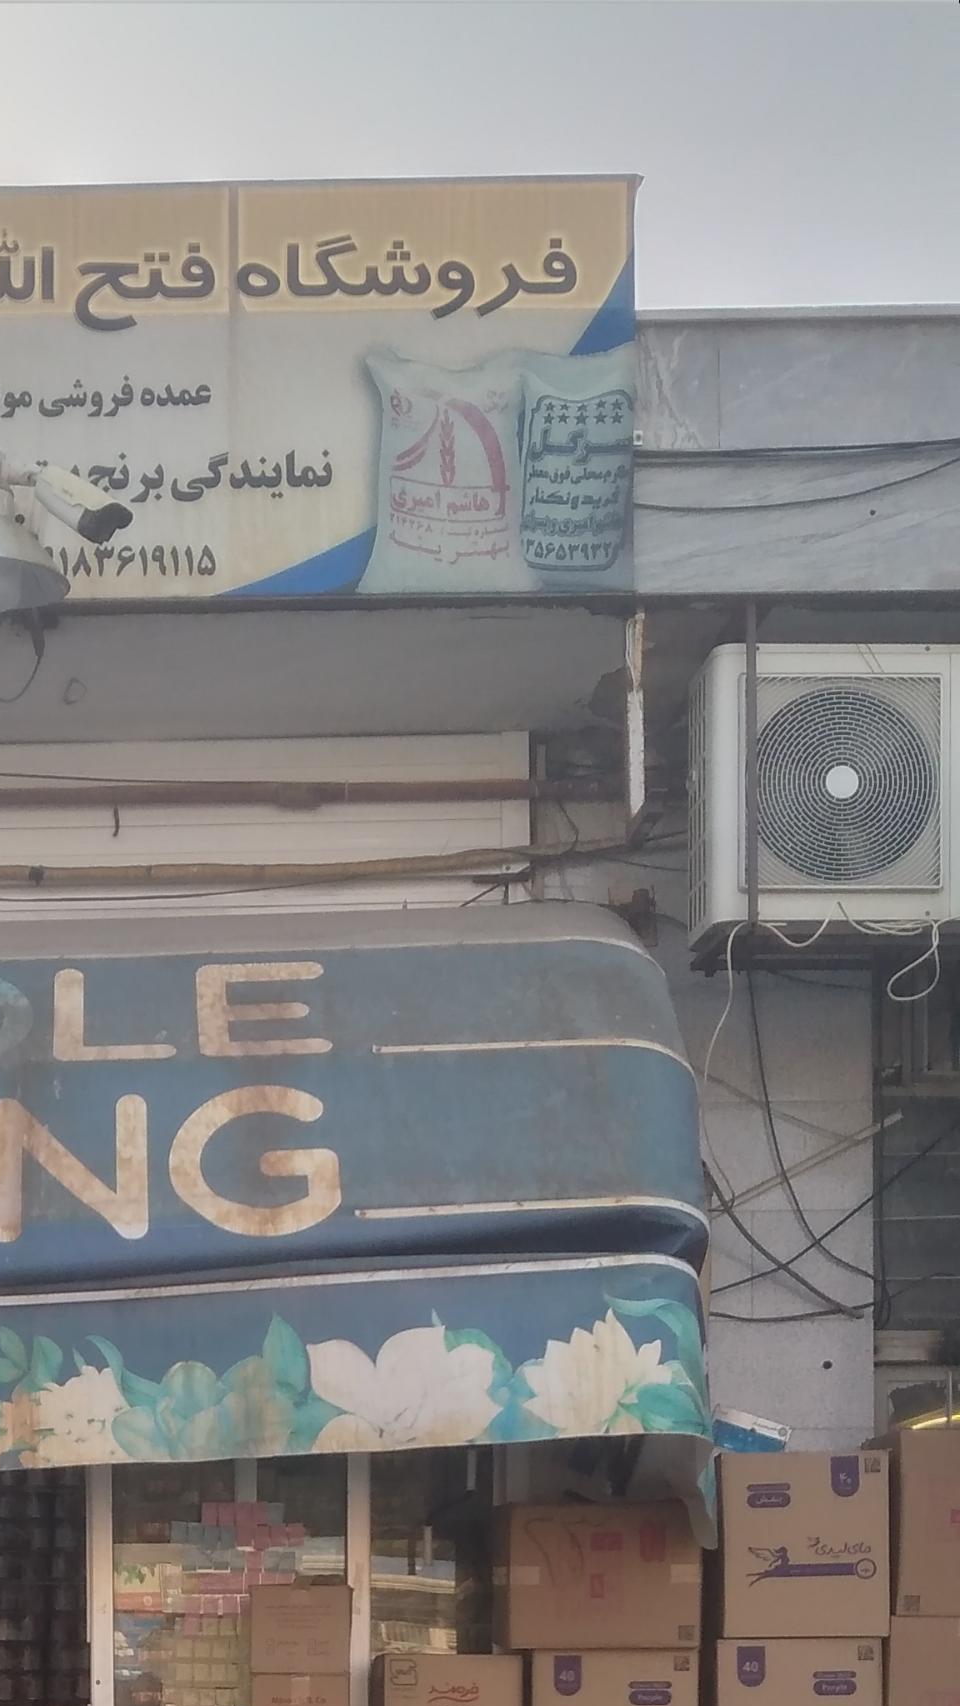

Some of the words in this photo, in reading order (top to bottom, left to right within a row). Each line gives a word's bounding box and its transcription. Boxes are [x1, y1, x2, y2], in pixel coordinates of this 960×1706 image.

[74, 241, 216, 331] فتح
[235, 233, 580, 319] فروشگاه
[38, 376, 134, 418] فروشی
[140, 381, 212, 408] عمده
[87, 452, 165, 502] برنج
[170, 447, 333, 502] نمایندگی
[447, 491, 491, 518] هاشم
[44, 541, 217, 579] ۱۸۳۶۱۹۱۱۵
[559, 1669, 576, 1682] 40
[742, 1661, 759, 1673] 40
